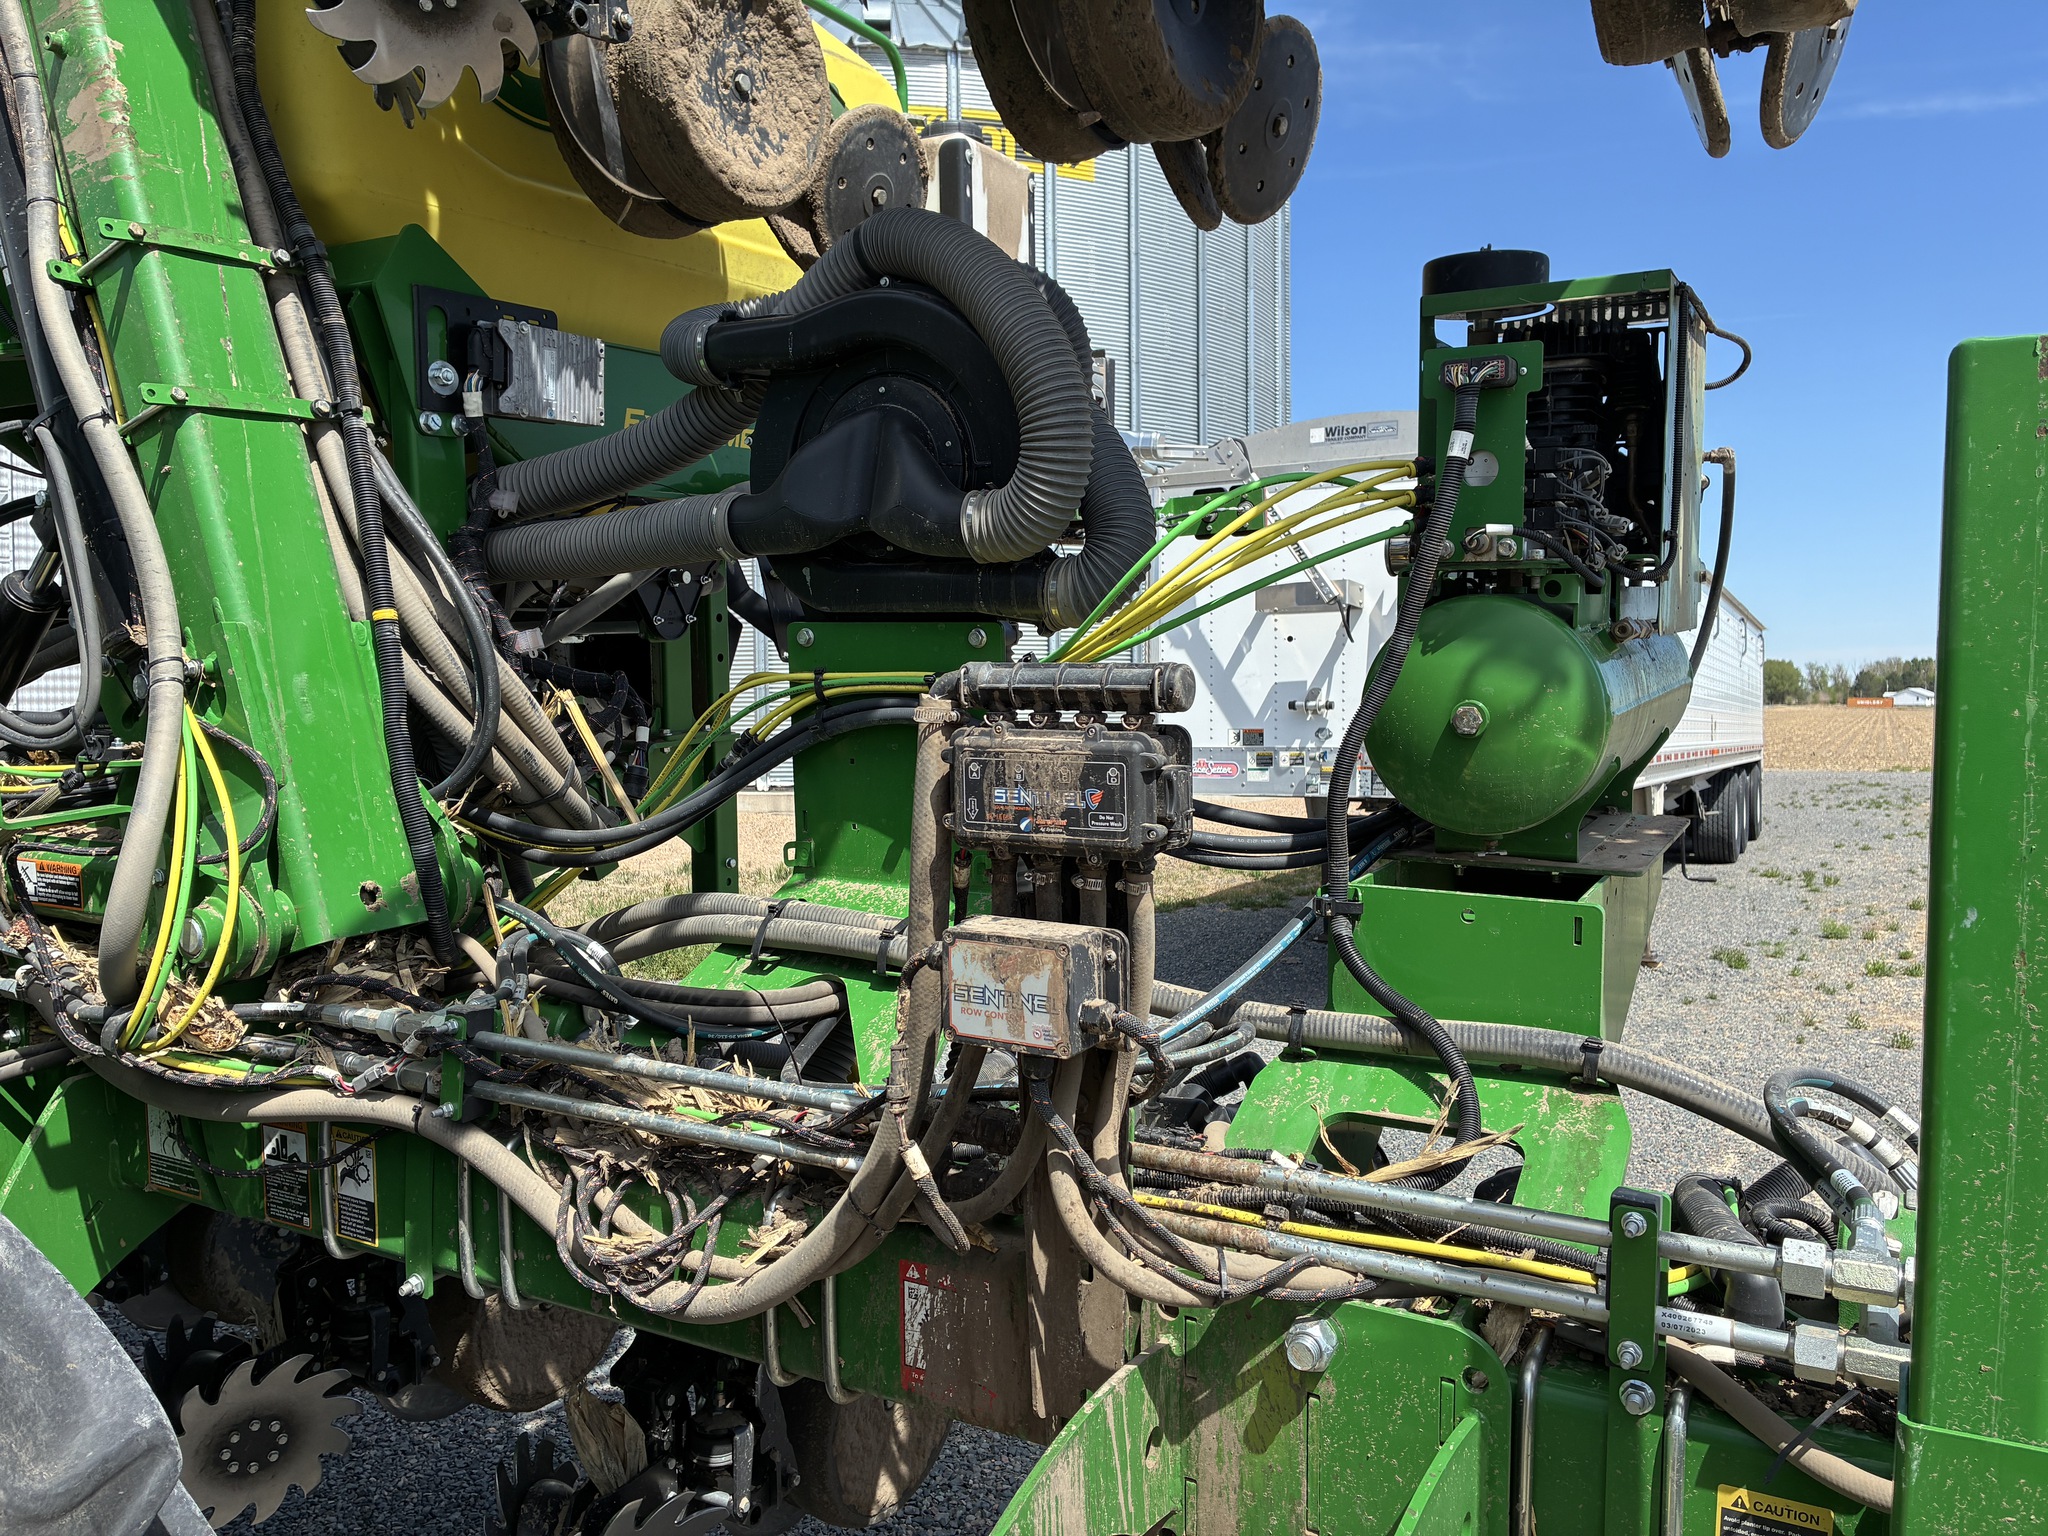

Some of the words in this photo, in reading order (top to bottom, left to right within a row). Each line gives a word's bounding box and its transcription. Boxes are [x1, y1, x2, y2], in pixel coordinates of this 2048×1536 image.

[1325, 425, 1366, 438] Wilson
[992, 784, 1086, 810] SENEL
[46, 864, 77, 874] WARNING
[954, 984, 1060, 1015] SENTNEL
[960, 1006, 982, 1016] ROW
[984, 1010, 1028, 1024] CONTL
[1818, 1184, 1832, 1200] GATES
[1660, 1322, 1706, 1335] 03/07/2023
[1753, 1500, 1820, 1526] CAUTION
[1724, 1515, 1740, 1524] Avoid
[1741, 1520, 1762, 1530] planter
[1762, 1524, 1770, 1532] tip
[1771, 1526, 1786, 1535] over.
